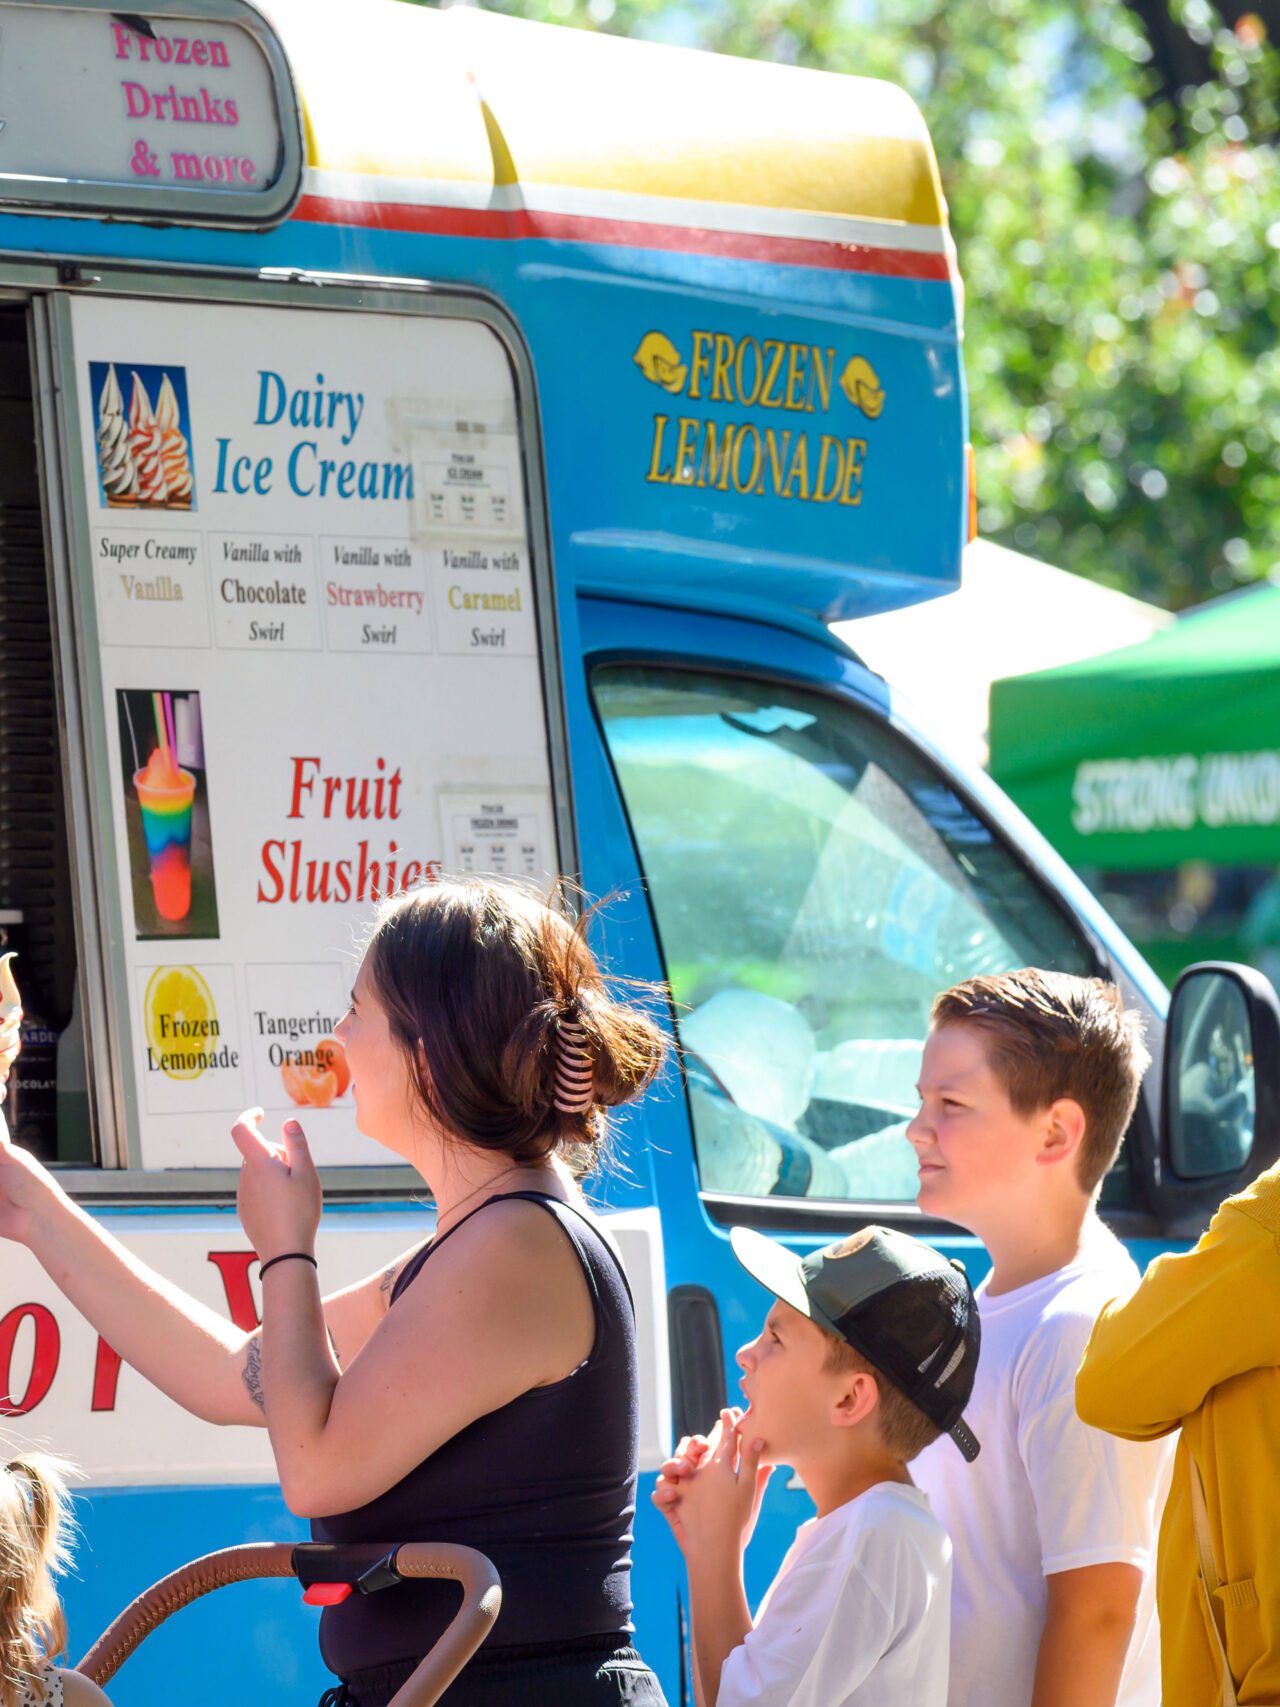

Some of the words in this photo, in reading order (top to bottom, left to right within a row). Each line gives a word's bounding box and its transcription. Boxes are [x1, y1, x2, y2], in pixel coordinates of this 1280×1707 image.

[111, 21, 231, 68] Frozen
[125, 82, 240, 128] Drinks
[128, 140, 162, 179] &
[172, 151, 257, 185] more
[687, 329, 837, 413] FROZEN
[254, 369, 365, 445] Dairy
[211, 437, 274, 496] Ice
[287, 440, 415, 501] Cream
[646, 413, 868, 507] LEMONADE
[99, 538, 141, 564] Super
[144, 540, 197, 567] Creamy
[222, 542, 270, 564] Vanilla
[274, 544, 302, 564] with
[332, 545, 380, 567] Vanilla
[384, 547, 412, 568] with
[441, 549, 487, 571] Vanilla
[490, 551, 520, 572] with
[121, 574, 184, 602] Vanilla
[220, 577, 307, 606] Chocolate
[326, 581, 424, 615] Strawberry
[448, 585, 522, 612] Caramel
[249, 620, 285, 643] Swirl
[362, 624, 397, 646] Swirl
[471, 627, 506, 648] Swirl
[286, 756, 403, 820] Fruit
[1072, 755, 1198, 835] STRONG
[159, 1012, 221, 1039] Frozen
[146, 1045, 240, 1073] Lemonade
[268, 1043, 335, 1073] Orange
